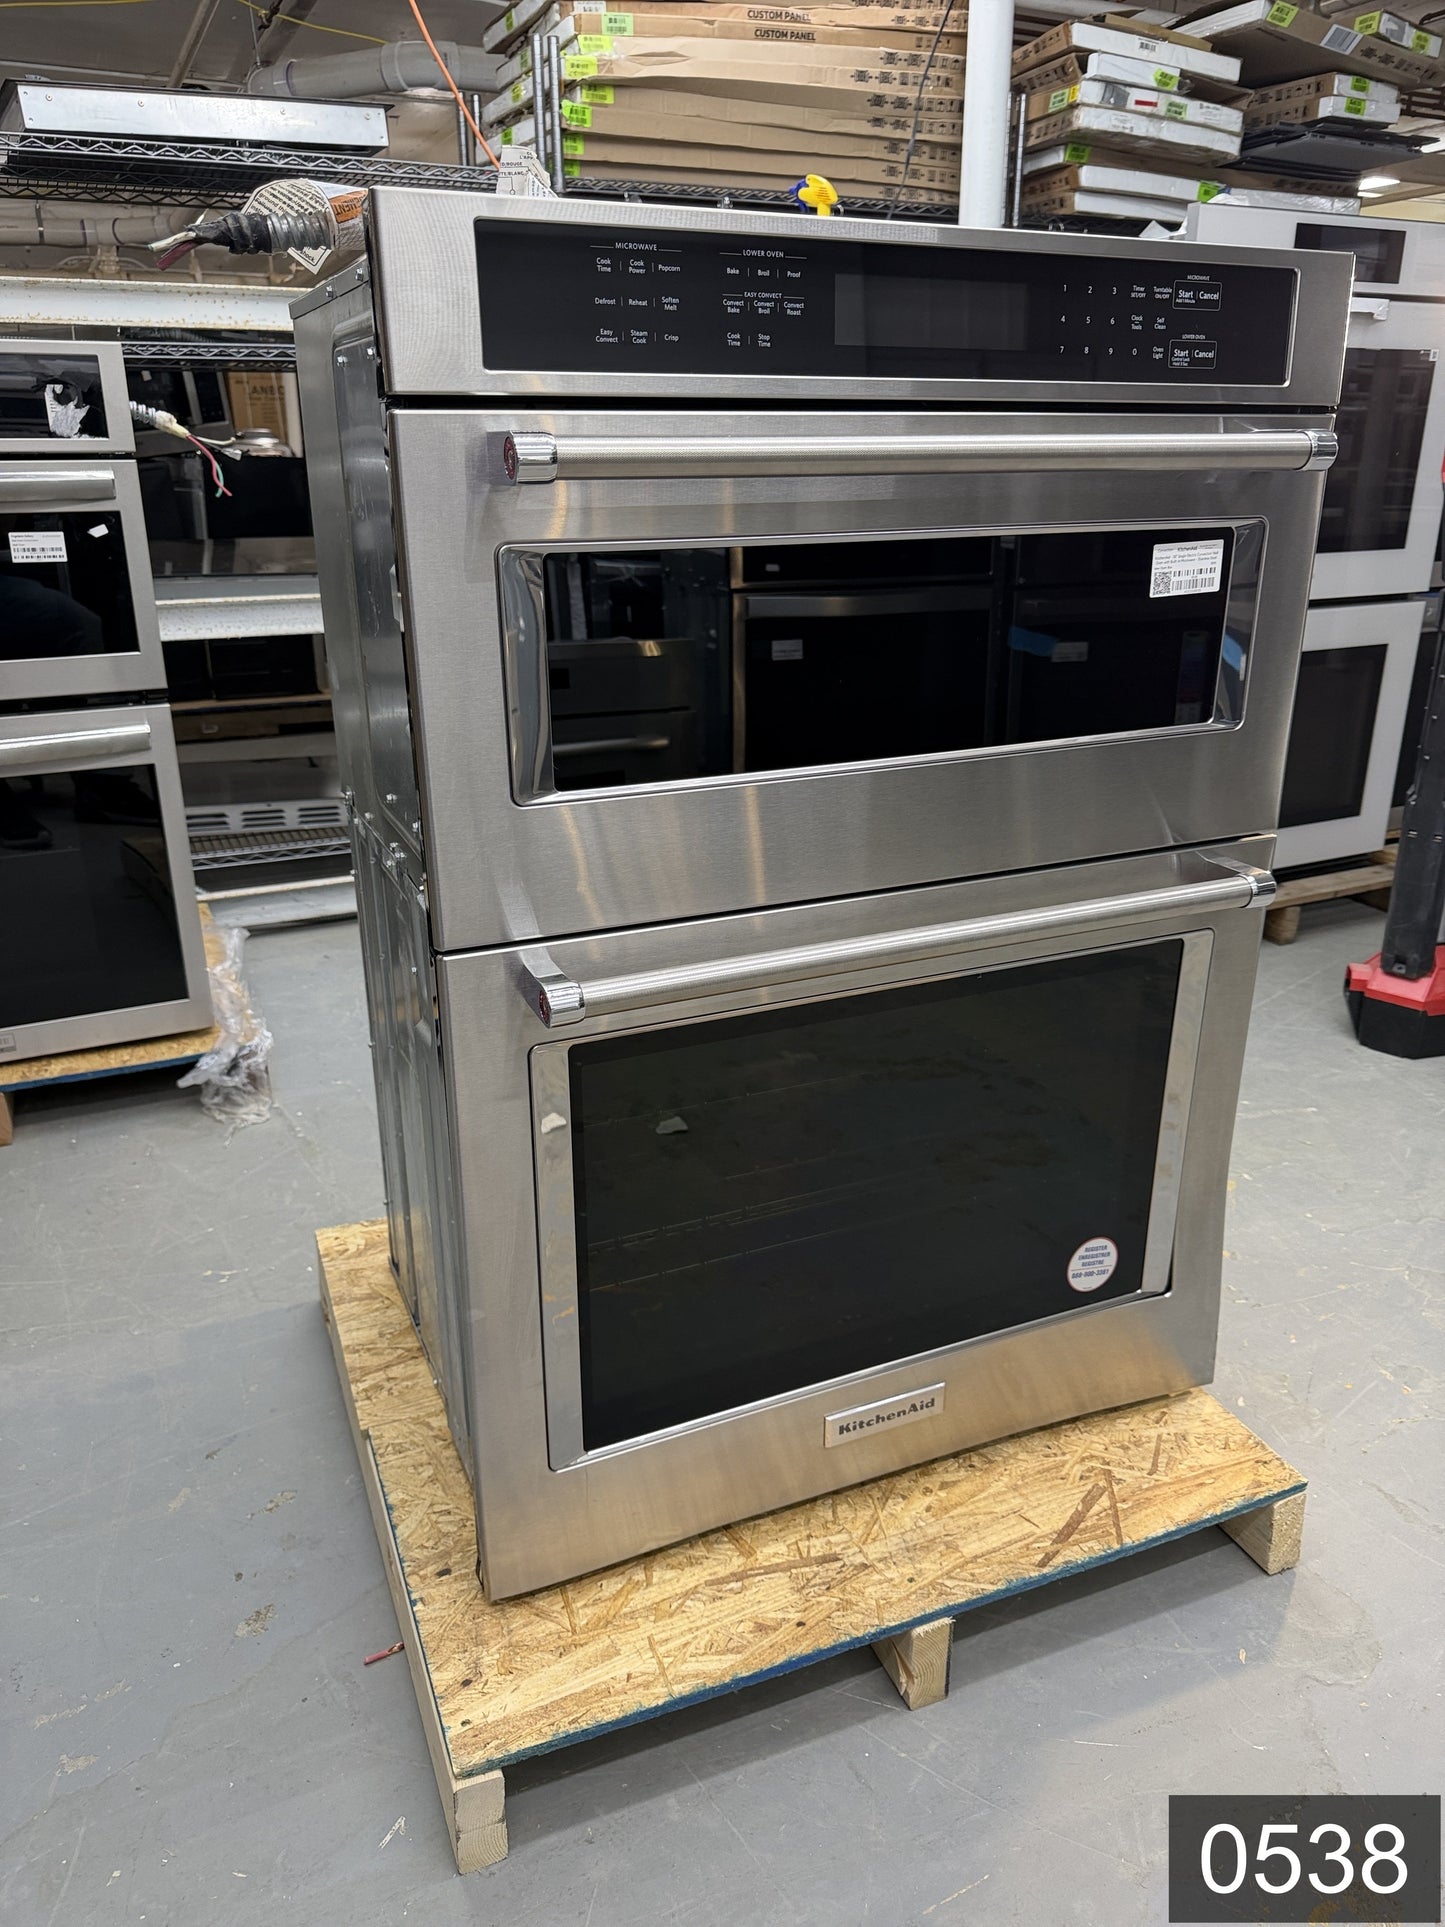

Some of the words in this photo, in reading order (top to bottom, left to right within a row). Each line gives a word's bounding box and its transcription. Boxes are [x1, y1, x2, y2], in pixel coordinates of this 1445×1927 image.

[747, 10, 782, 19] CUSTOM
[784, 12, 811, 21] PANEL
[755, 29, 788, 38] CUSTOM
[790, 32, 816, 40] PANEL
[1063, 284, 1067, 292] 1
[1179, 290, 1193, 298] Start
[1199, 291, 1219, 300] Cancel
[662, 296, 679, 304] Soften
[600, 328, 613, 336] Easy
[664, 334, 679, 342] Crisp
[1109, 347, 1113, 355] 9
[1174, 349, 1188, 357] Start
[1195, 350, 1214, 358] Cancel
[839, 1398, 935, 1435] KitchenAid
